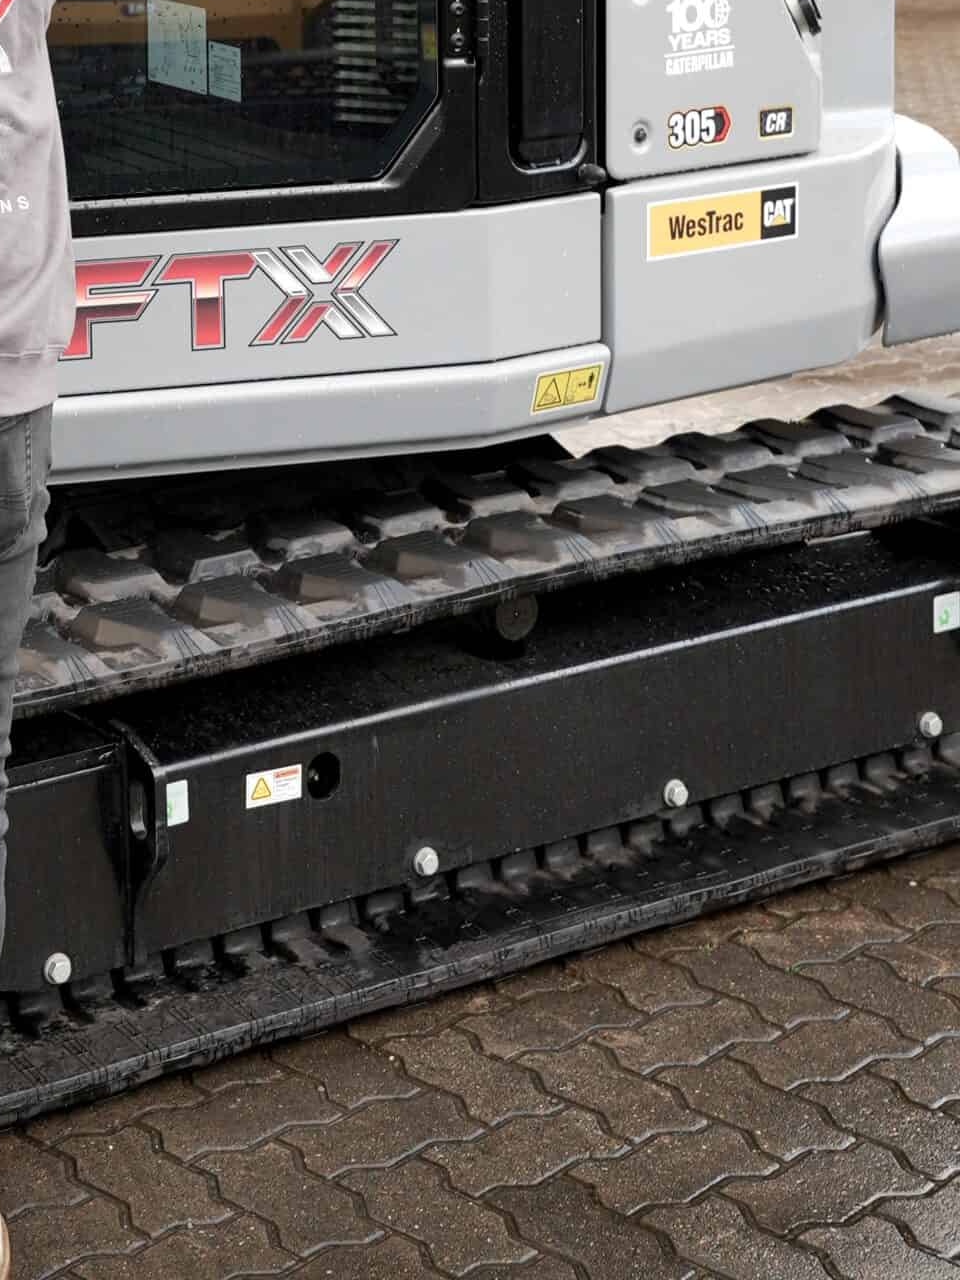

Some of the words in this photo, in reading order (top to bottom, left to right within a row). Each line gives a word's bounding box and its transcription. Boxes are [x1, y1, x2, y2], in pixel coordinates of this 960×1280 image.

[667, 27, 732, 52] YEARS
[664, 51, 735, 76] CATERPILLAR
[668, 108, 717, 150] 305
[764, 111, 788, 134] CR
[668, 210, 744, 241] WesTrac
[763, 198, 794, 227] CAT
[58, 238, 401, 362] FTX
